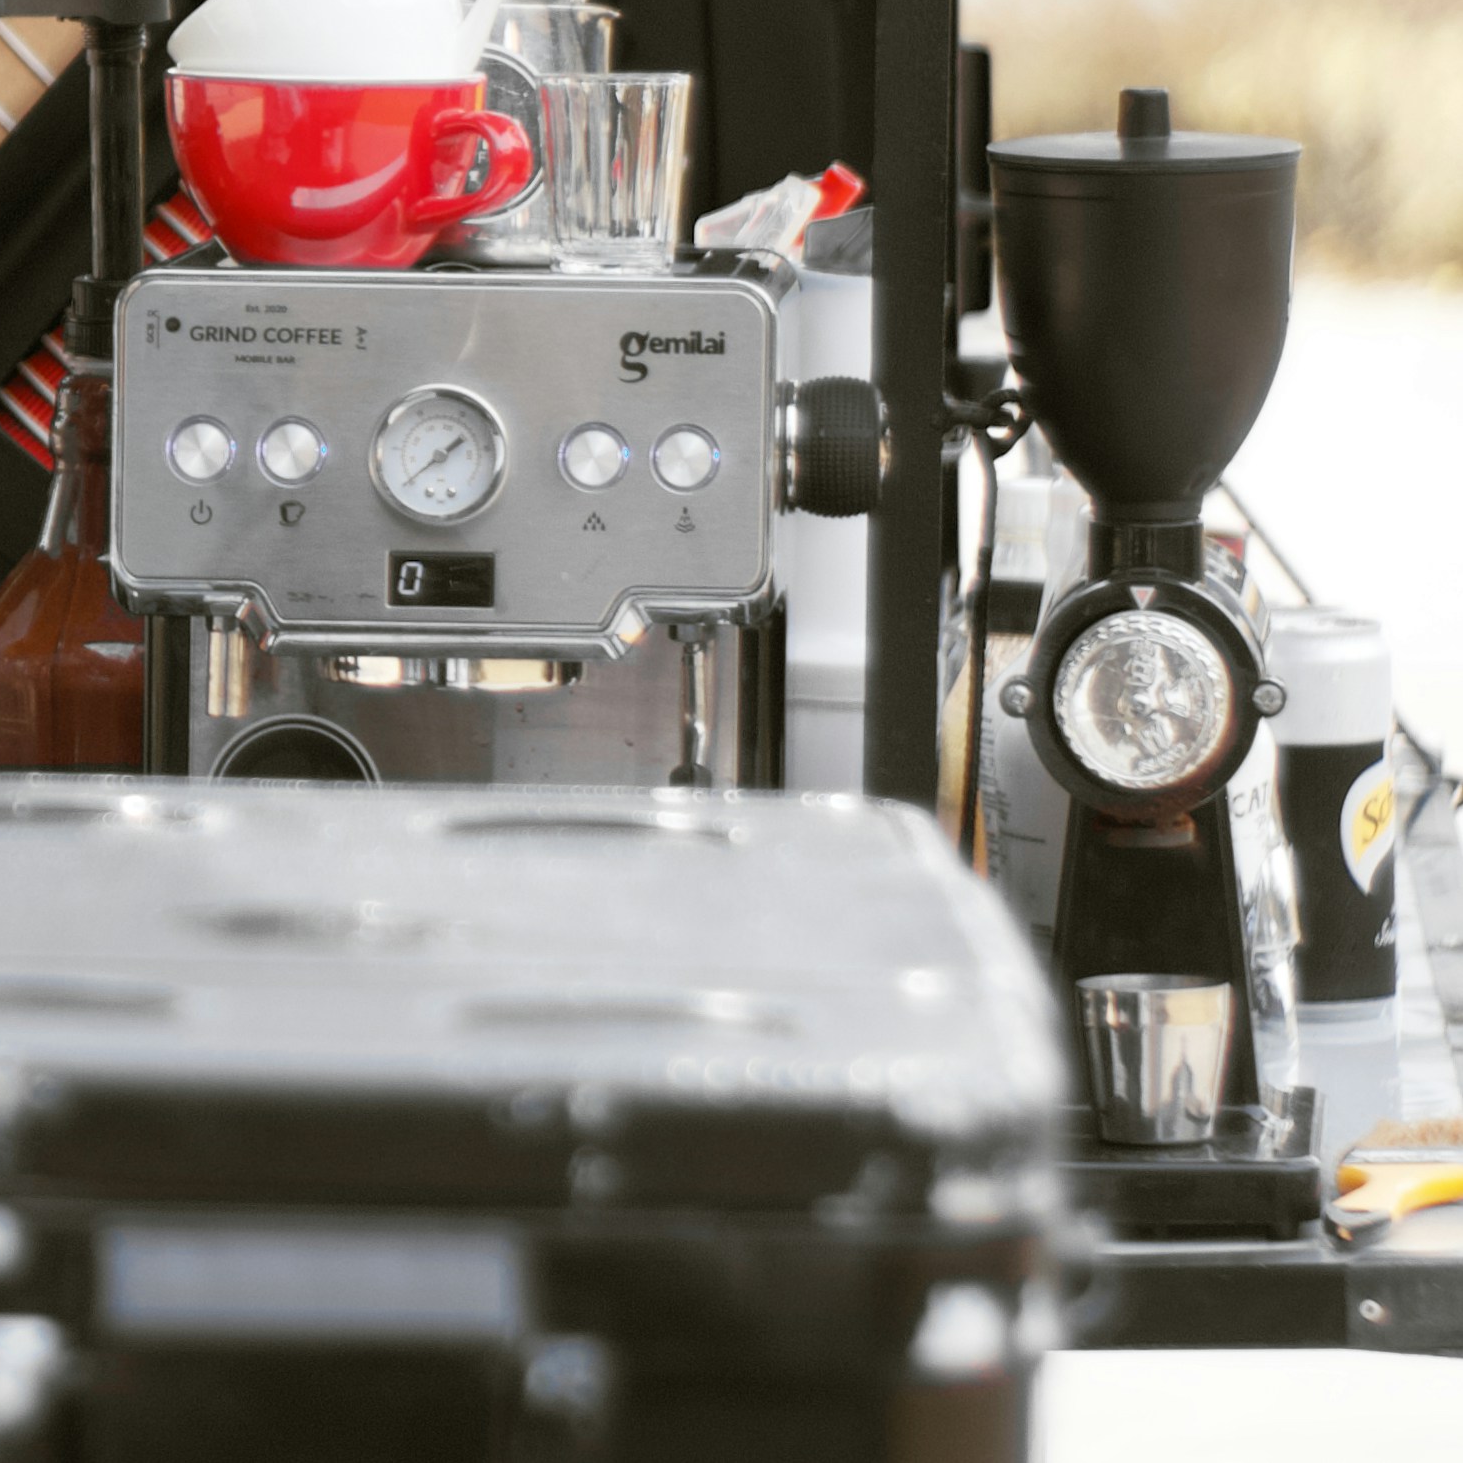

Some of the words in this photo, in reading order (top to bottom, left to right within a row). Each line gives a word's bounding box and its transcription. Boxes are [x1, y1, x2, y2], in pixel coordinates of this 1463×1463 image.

[189, 326, 257, 343] GRIND
[263, 327, 343, 345] COFFEE
[235, 354, 273, 364] MOBILE
[276, 355, 296, 365] BAR
[616, 330, 725, 383] gemilai
[398, 561, 423, 596] 0
